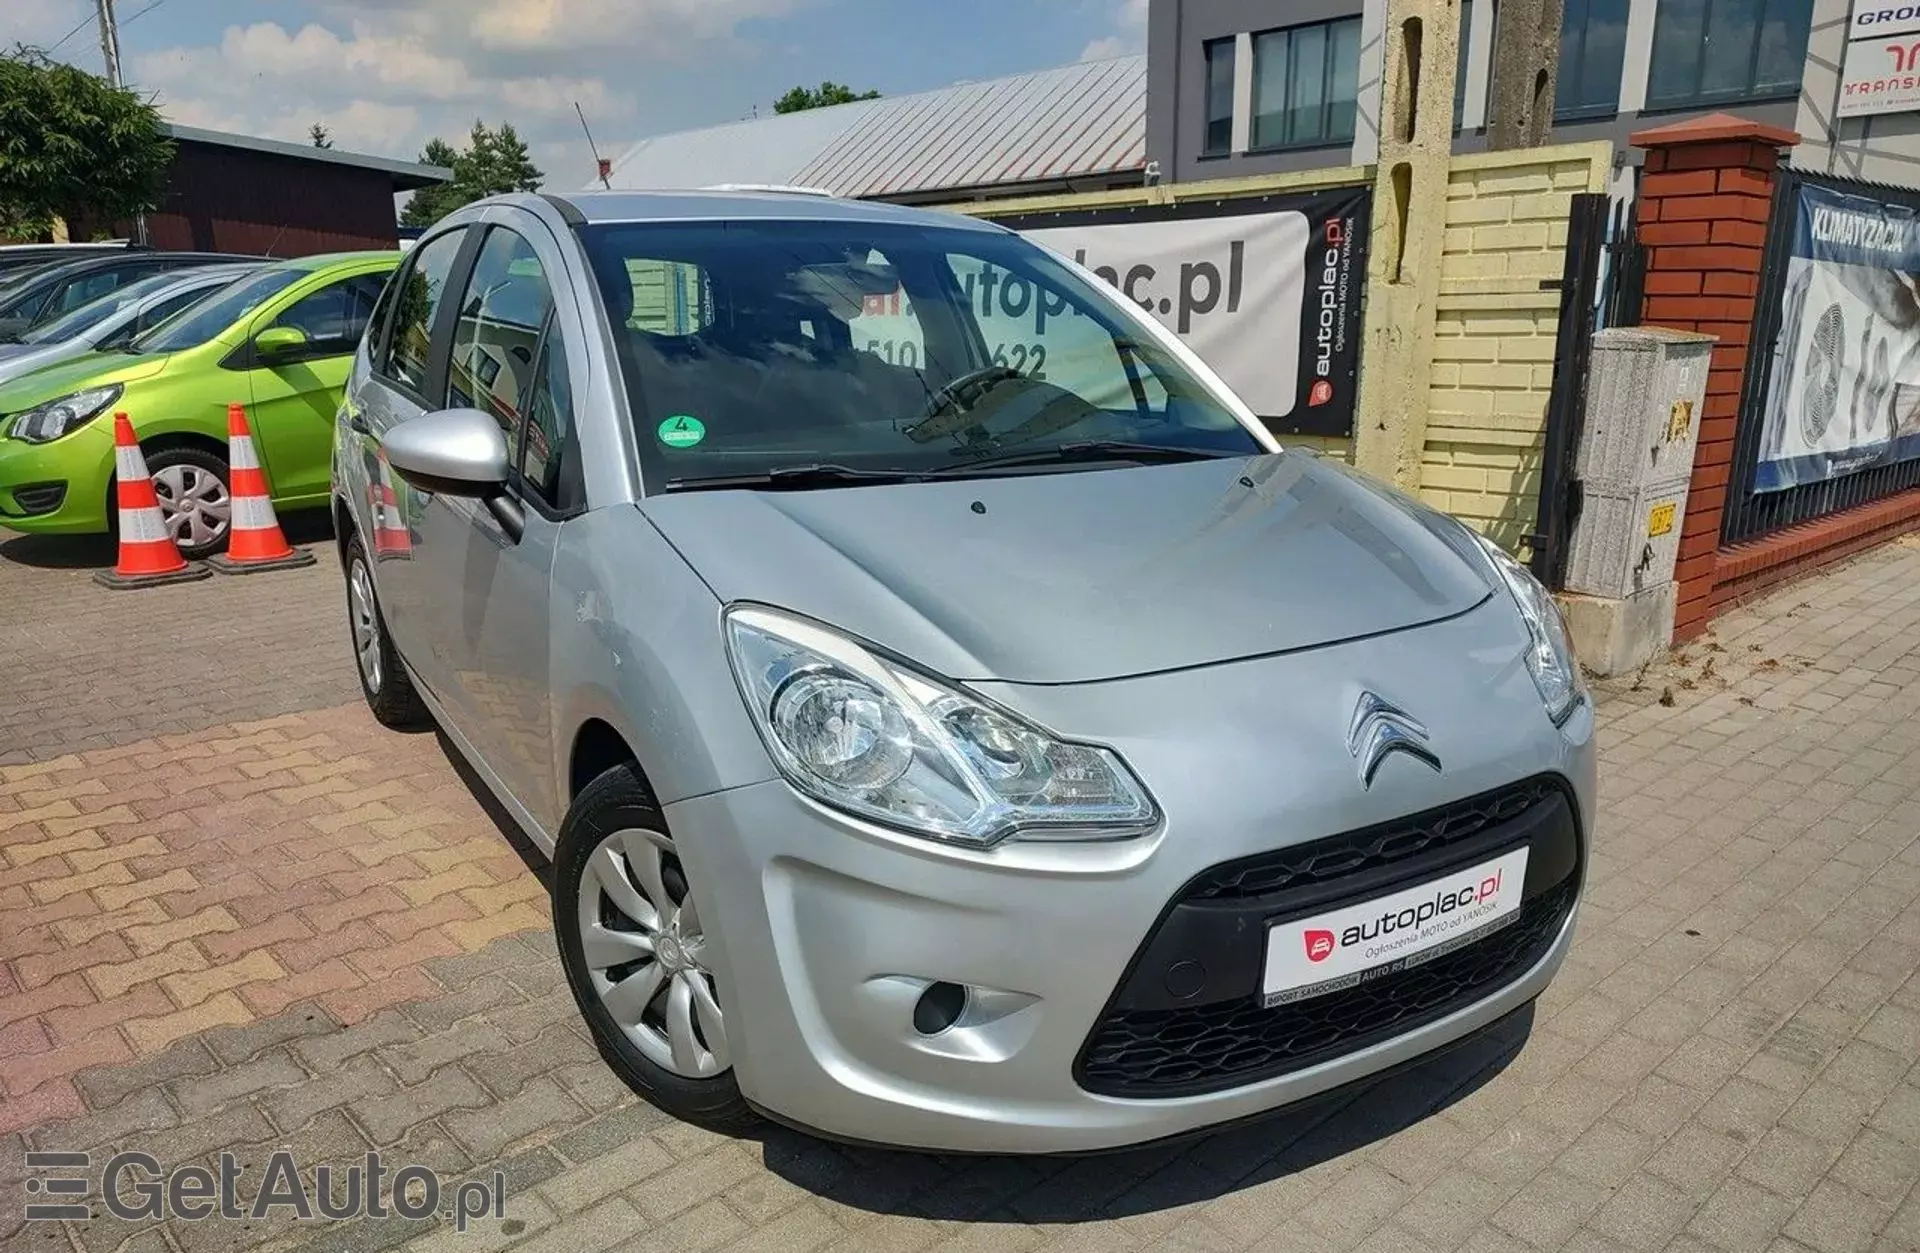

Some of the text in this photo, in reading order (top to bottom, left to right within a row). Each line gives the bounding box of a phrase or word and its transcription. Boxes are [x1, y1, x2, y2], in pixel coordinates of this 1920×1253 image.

[1857, 6, 1920, 25] GRO
[1845, 76, 1920, 96] TRANS
[1339, 273, 1348, 301] MOTO
[1316, 218, 1343, 376] autoplac.pl
[675, 417, 688, 431] 4
[1341, 868, 1502, 947] autoplac.pl
[1420, 920, 1448, 939] MOTO
[1362, 965, 1389, 982] AUTO
